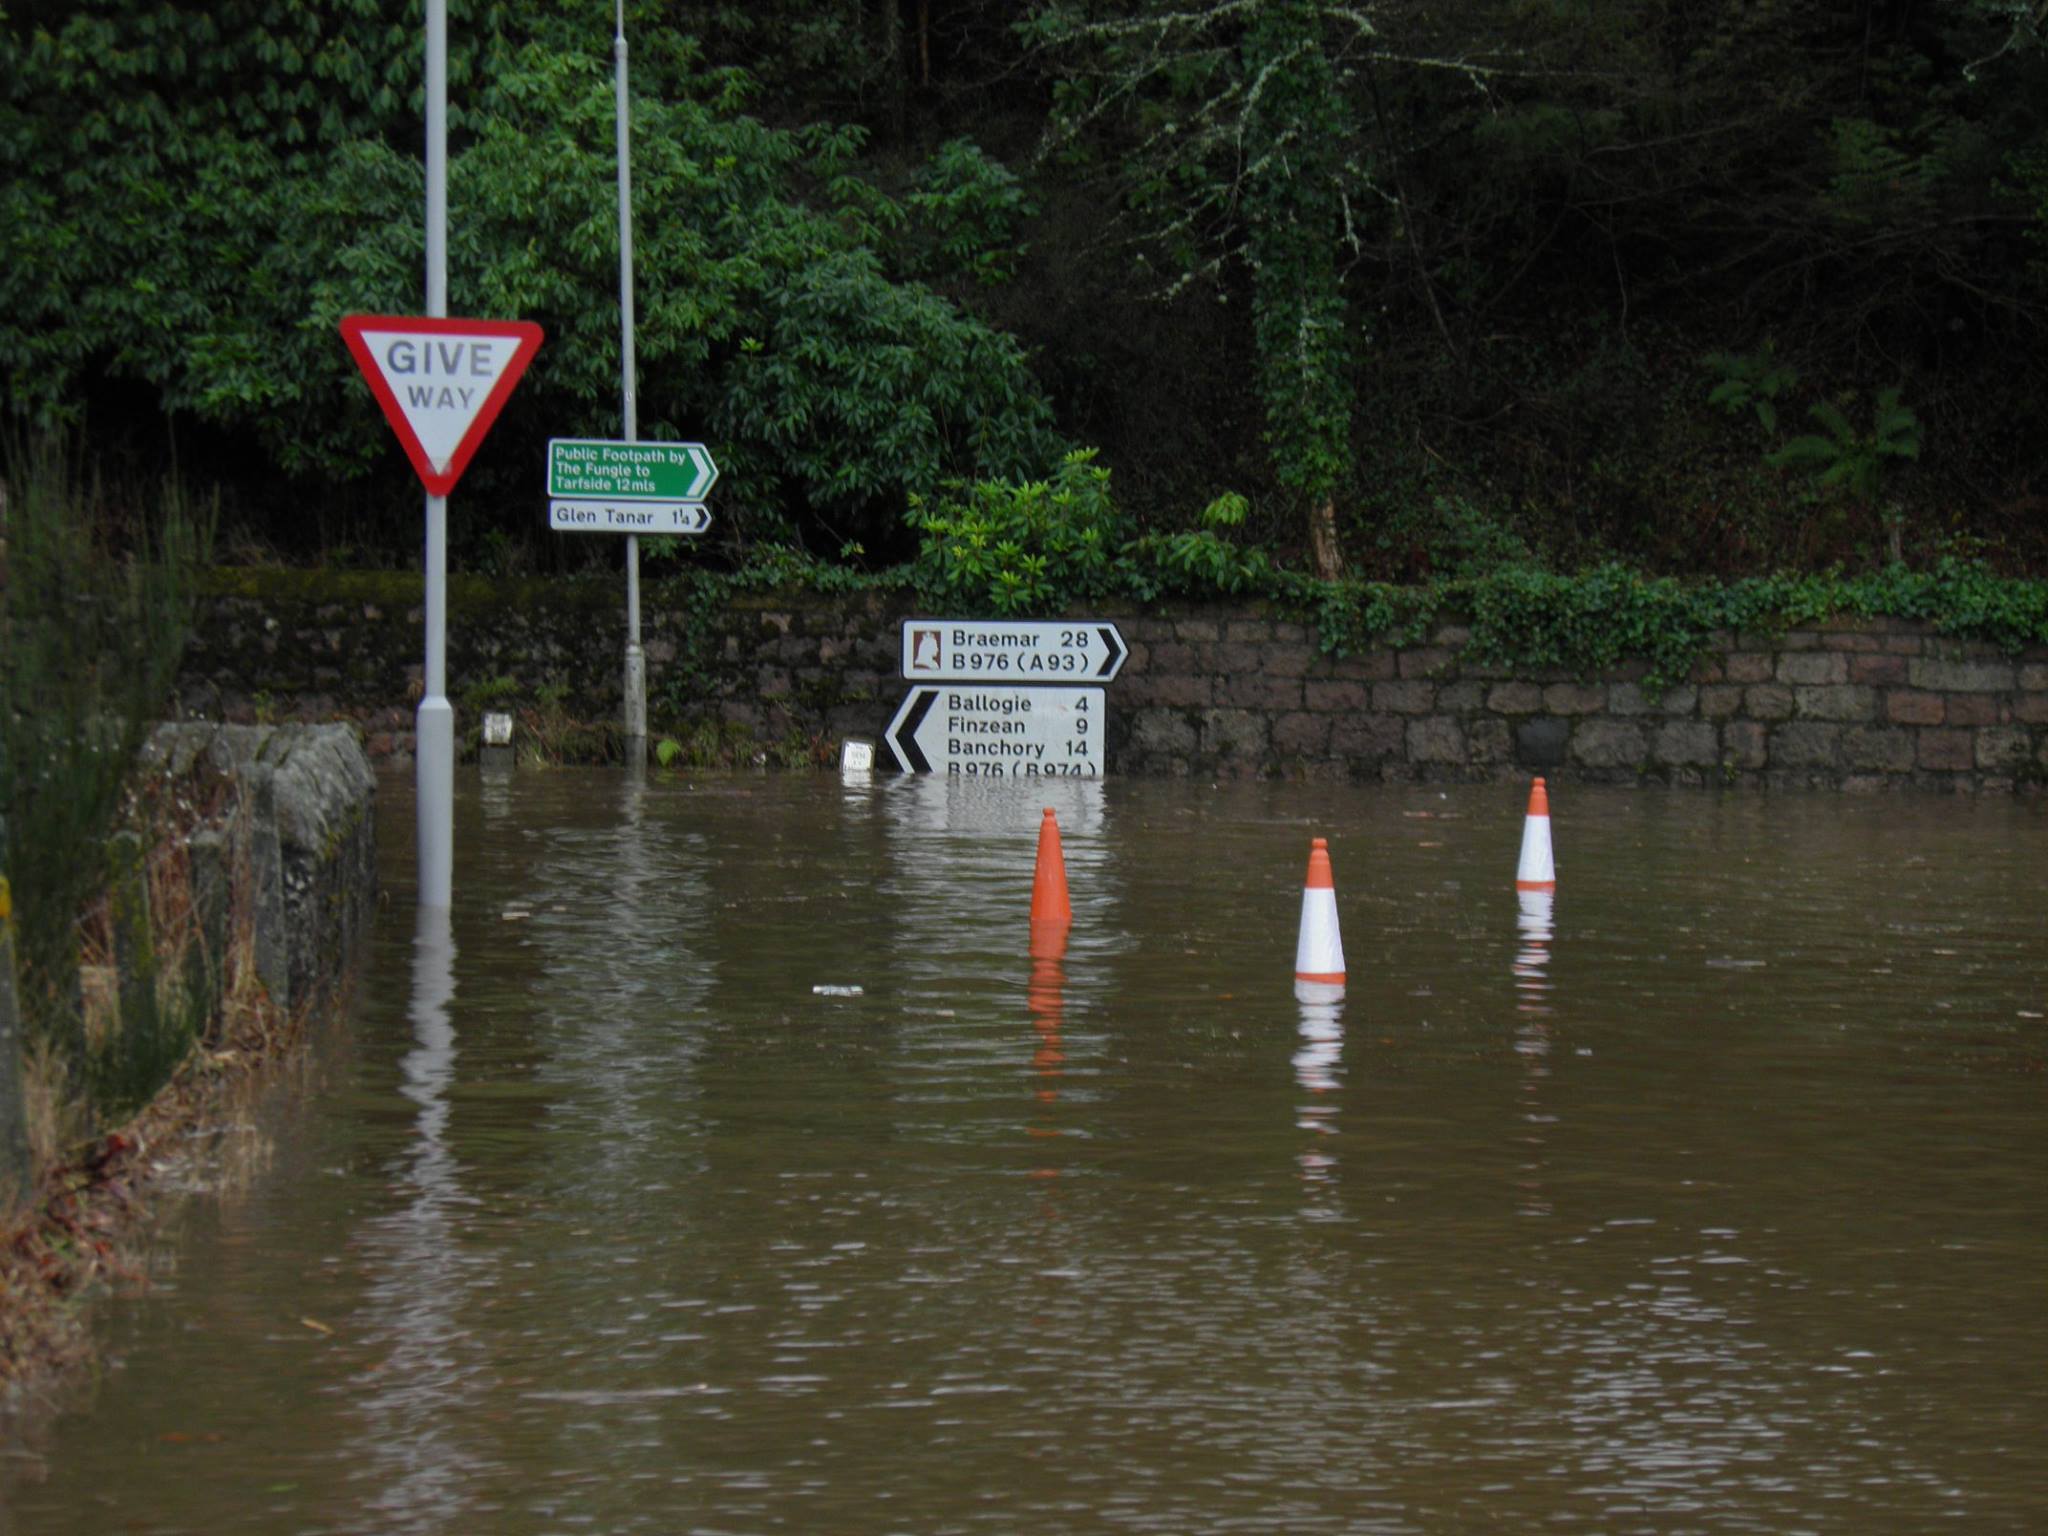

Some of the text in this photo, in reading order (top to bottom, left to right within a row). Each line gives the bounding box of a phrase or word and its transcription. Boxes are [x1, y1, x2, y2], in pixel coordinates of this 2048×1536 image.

[387, 341, 493, 376] GIVE
[407, 386, 475, 409] WAY
[556, 447, 685, 466] Public Footpath by
[556, 462, 650, 478] The Fungle to
[556, 476, 611, 490] Tarfside
[557, 507, 596, 523] Glen
[605, 509, 654, 524] Tanar
[952, 630, 1088, 648] Braemar 28
[948, 694, 1089, 715] Ballogie 4
[948, 717, 1088, 734] Finzean 9
[948, 739, 1089, 759] Banchory 14
